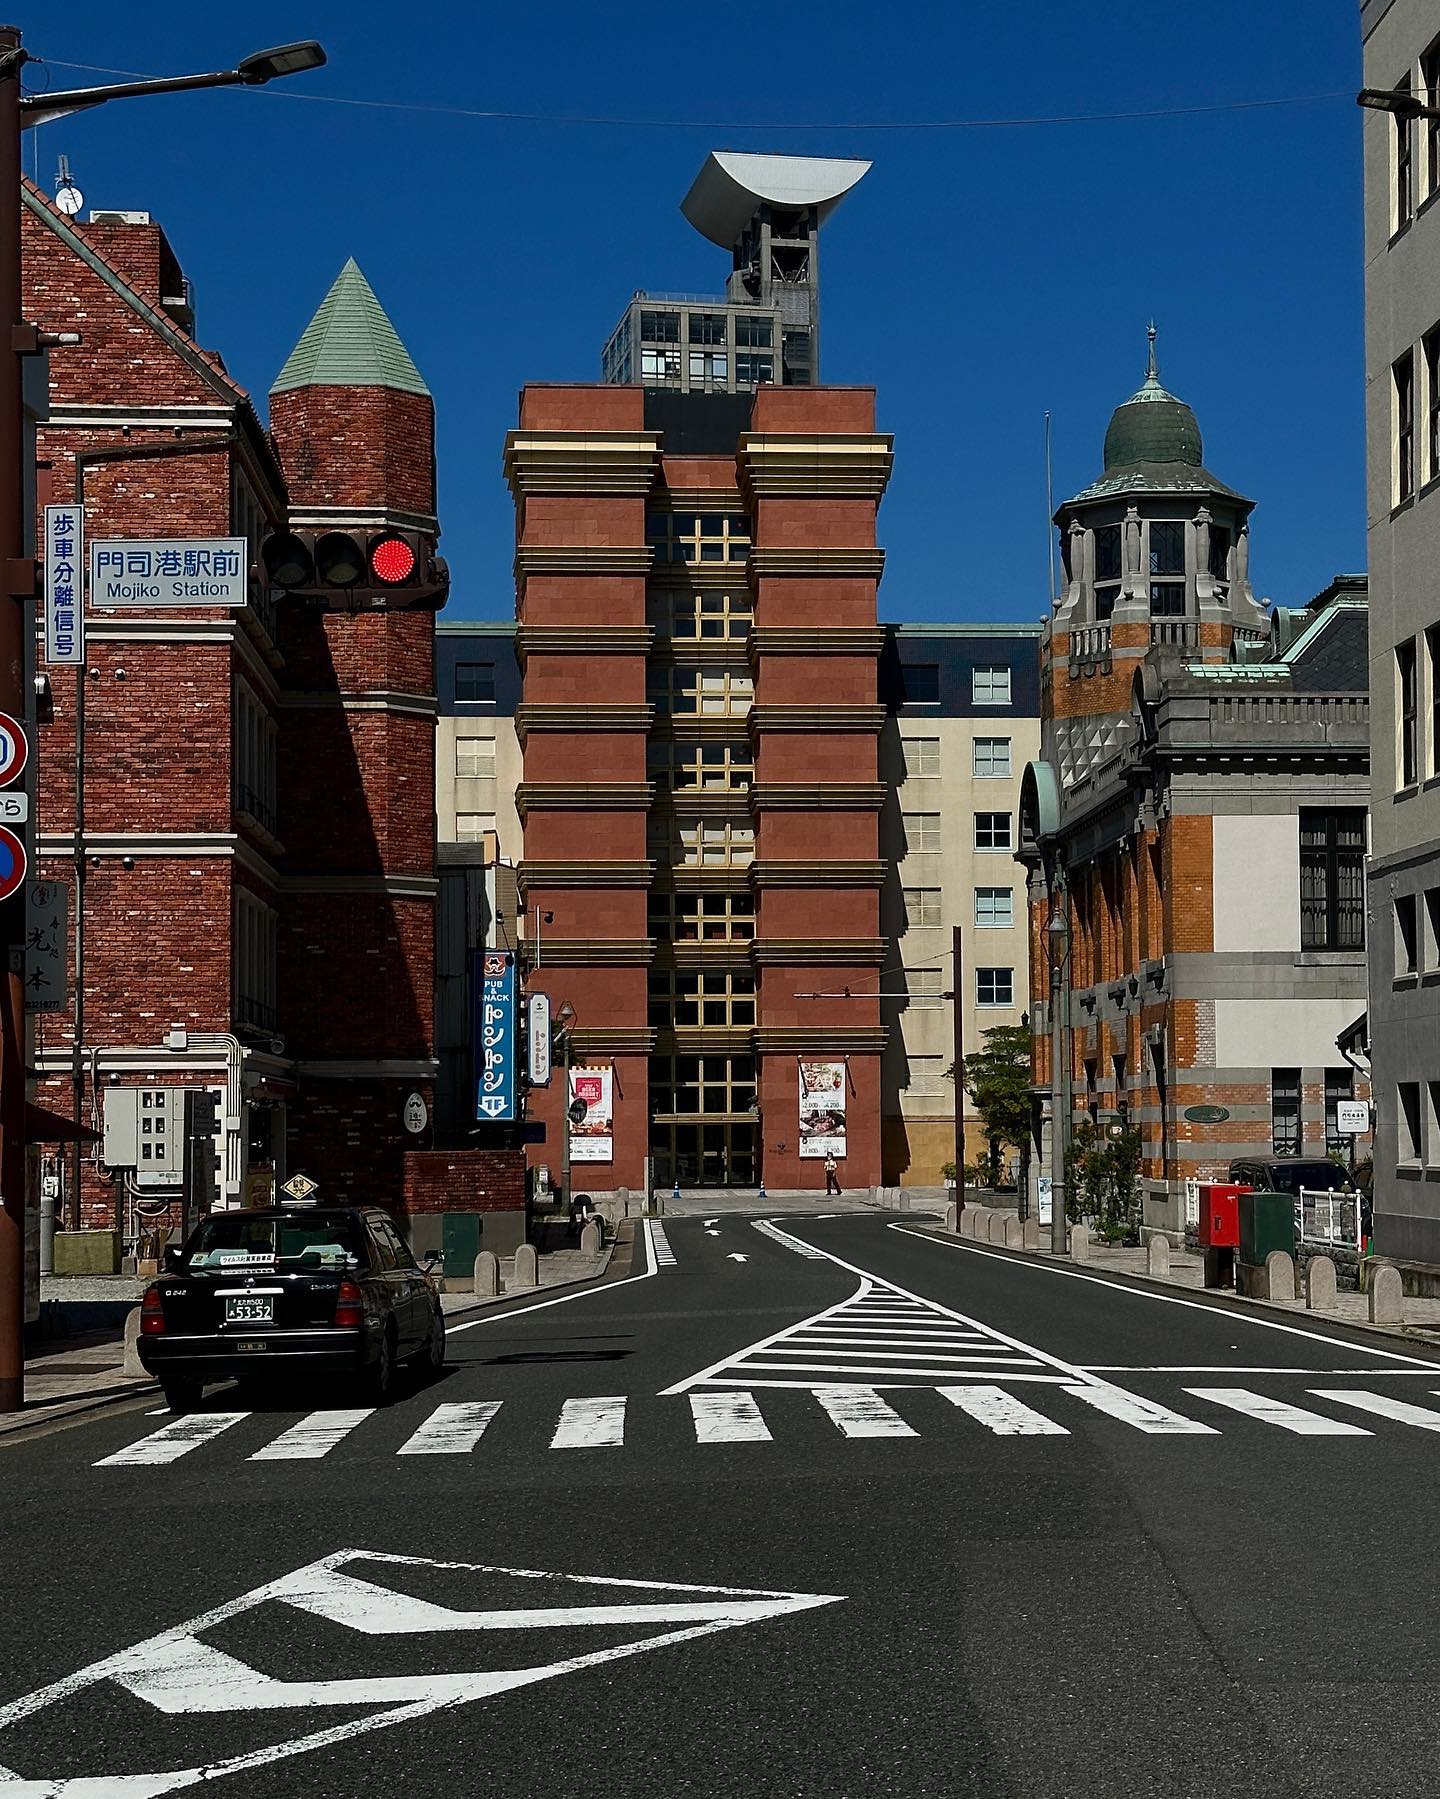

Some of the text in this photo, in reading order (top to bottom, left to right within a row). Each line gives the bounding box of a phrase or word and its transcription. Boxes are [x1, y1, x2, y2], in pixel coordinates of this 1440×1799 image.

[97, 549, 240, 579] 門司港駅前
[53, 513, 75, 656] 歩車分離信号
[107, 581, 230, 601] Mojiko Station
[484, 980, 503, 988] PUB
[490, 987, 498, 995] &
[484, 1098, 502, 1111] 1F
[236, 1305, 271, 1319] 53-52
